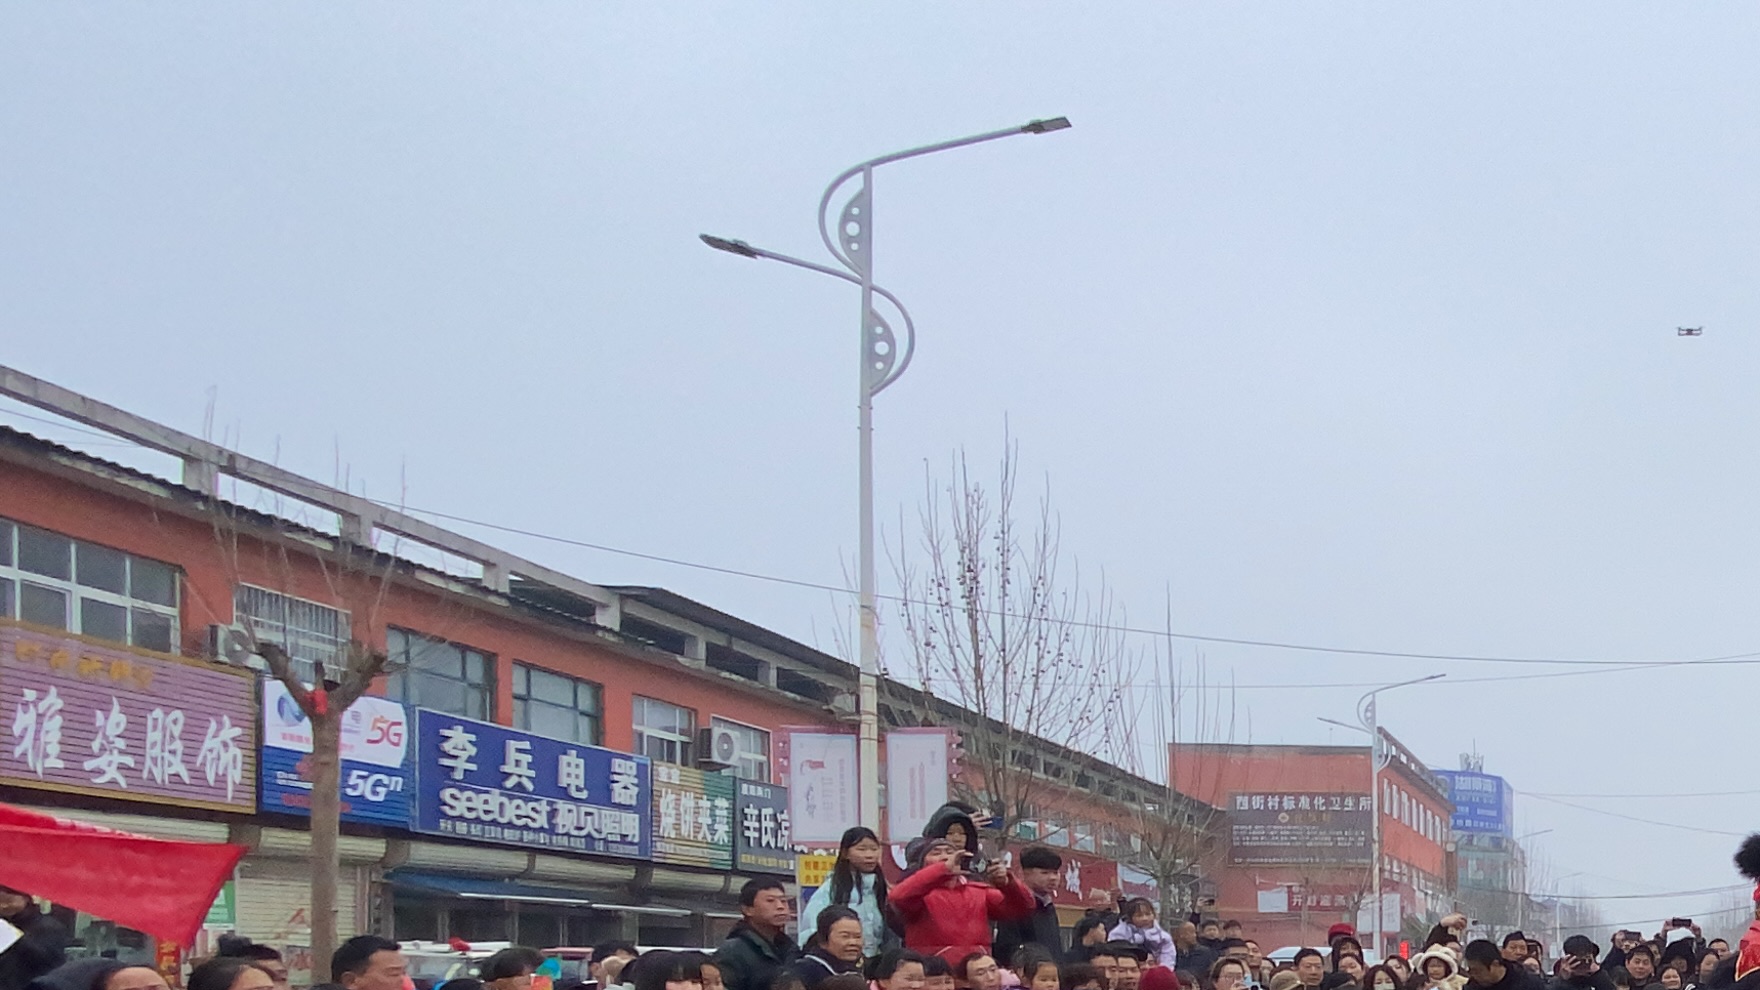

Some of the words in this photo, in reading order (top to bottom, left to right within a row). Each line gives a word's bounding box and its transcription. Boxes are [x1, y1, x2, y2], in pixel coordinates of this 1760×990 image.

[12, 685, 243, 802] 雅姿服饰
[366, 716, 403, 747] 5G
[438, 725, 640, 806] 李兵电器
[439, 787, 551, 829] seebest
[553, 800, 640, 843] 视贝照明
